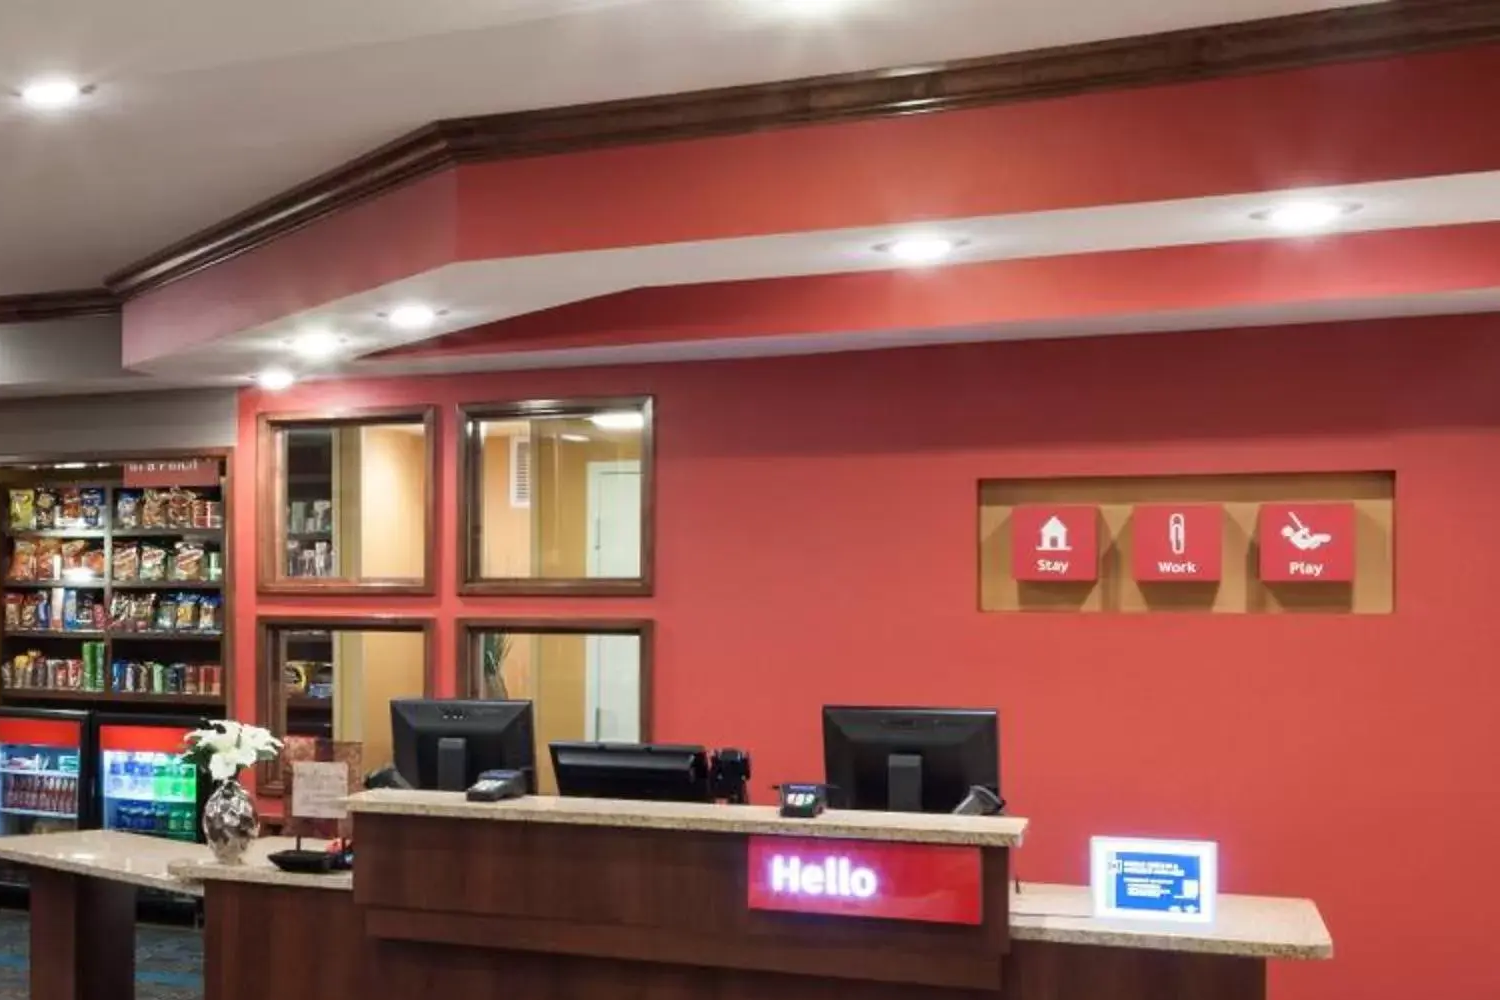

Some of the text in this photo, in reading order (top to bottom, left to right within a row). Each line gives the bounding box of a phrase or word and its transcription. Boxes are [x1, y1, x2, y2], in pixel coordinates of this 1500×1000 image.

[1037, 559, 1069, 574] Stay
[1158, 561, 1197, 574] Work
[1289, 561, 1324, 577] Play
[770, 854, 878, 898] Hello
